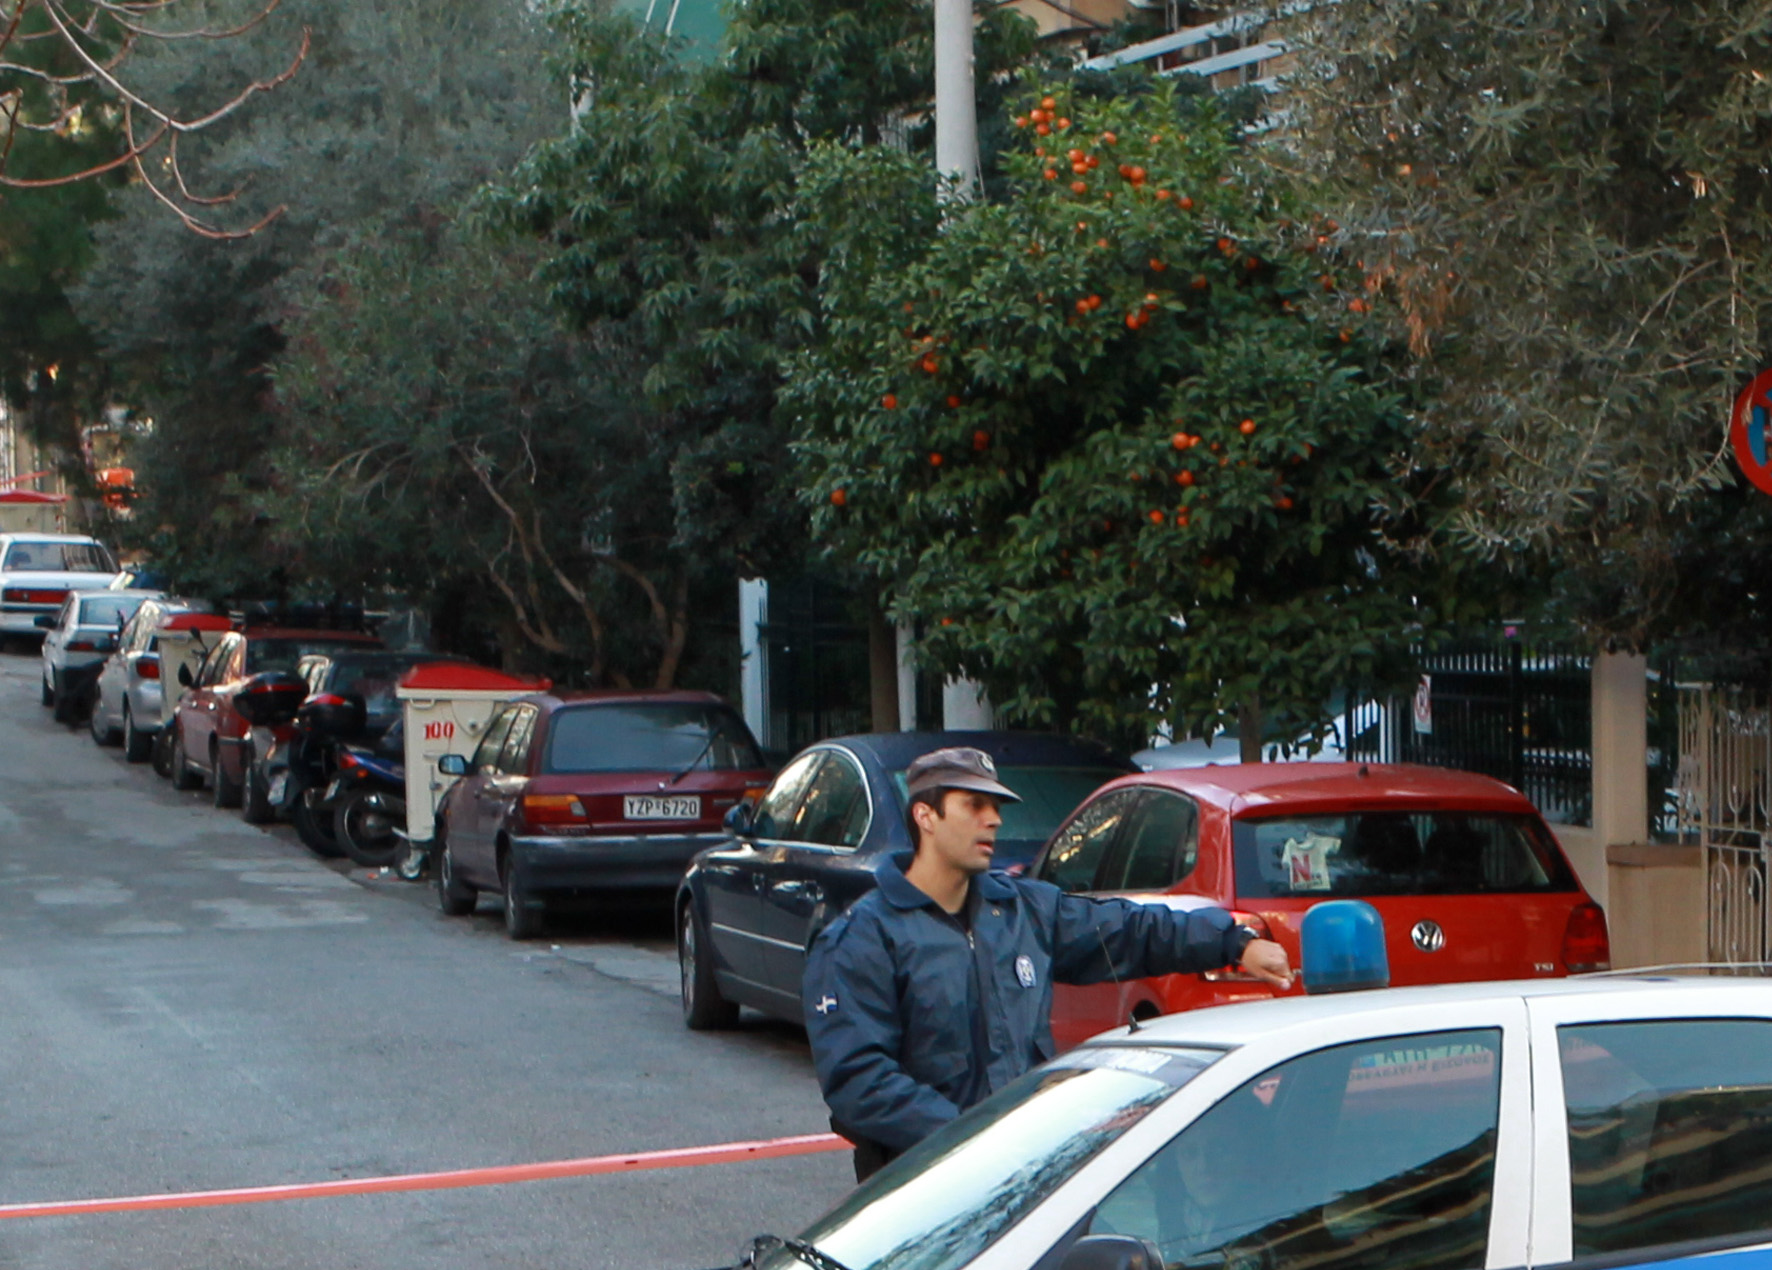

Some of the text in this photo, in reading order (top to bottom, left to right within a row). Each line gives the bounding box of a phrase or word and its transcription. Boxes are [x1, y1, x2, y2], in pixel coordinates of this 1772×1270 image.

[425, 721, 454, 740] 100
[627, 800, 653, 816] YZP
[662, 799, 697, 816] 6720
